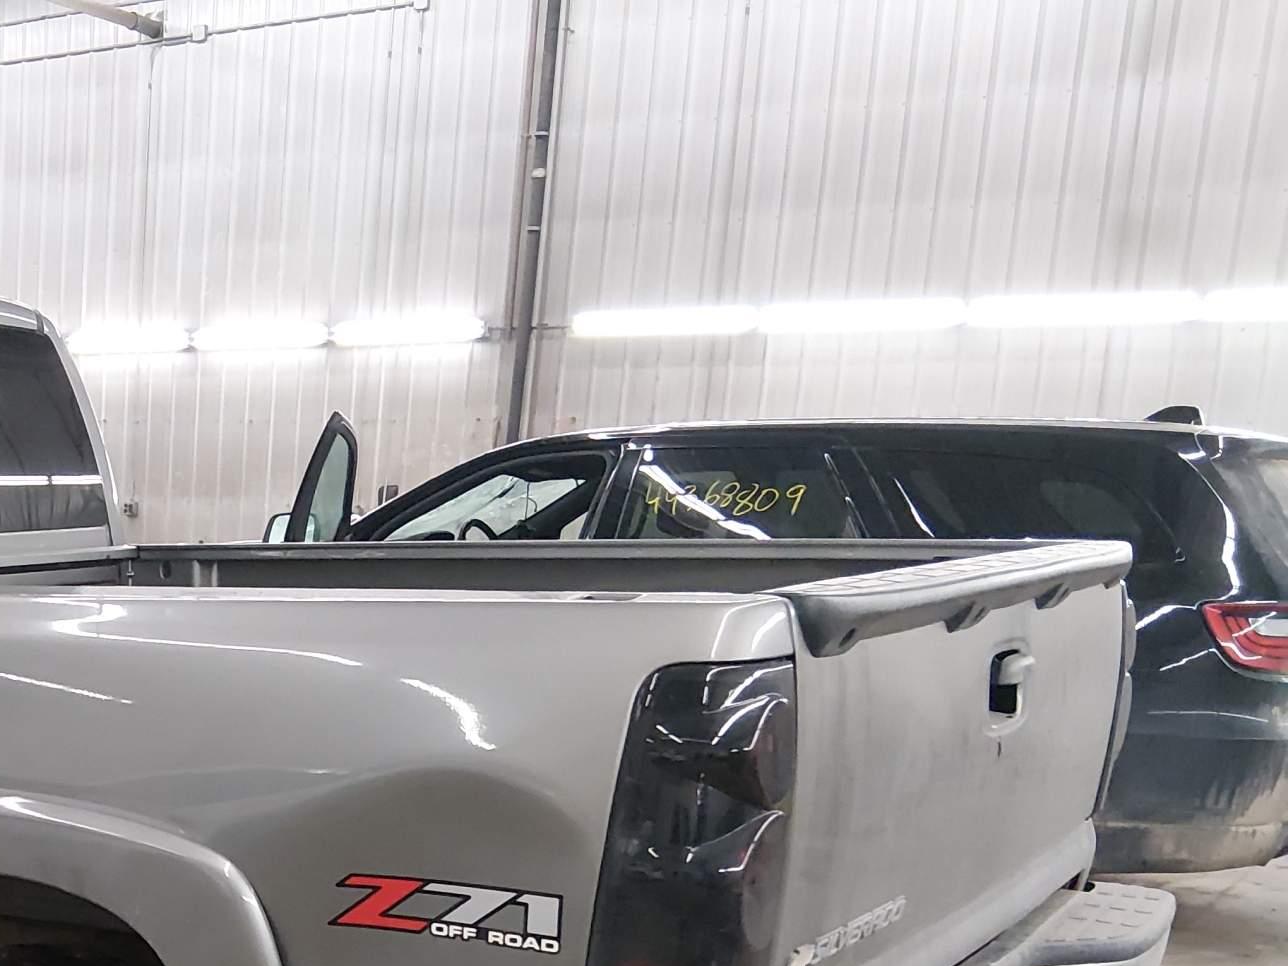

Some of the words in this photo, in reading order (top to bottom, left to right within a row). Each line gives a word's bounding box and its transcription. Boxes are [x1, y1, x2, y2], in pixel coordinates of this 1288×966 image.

[328, 873, 564, 938] Z71
[429, 922, 478, 941] OFF
[487, 930, 561, 954] ROAD
[810, 895, 907, 965] SILVERADO
